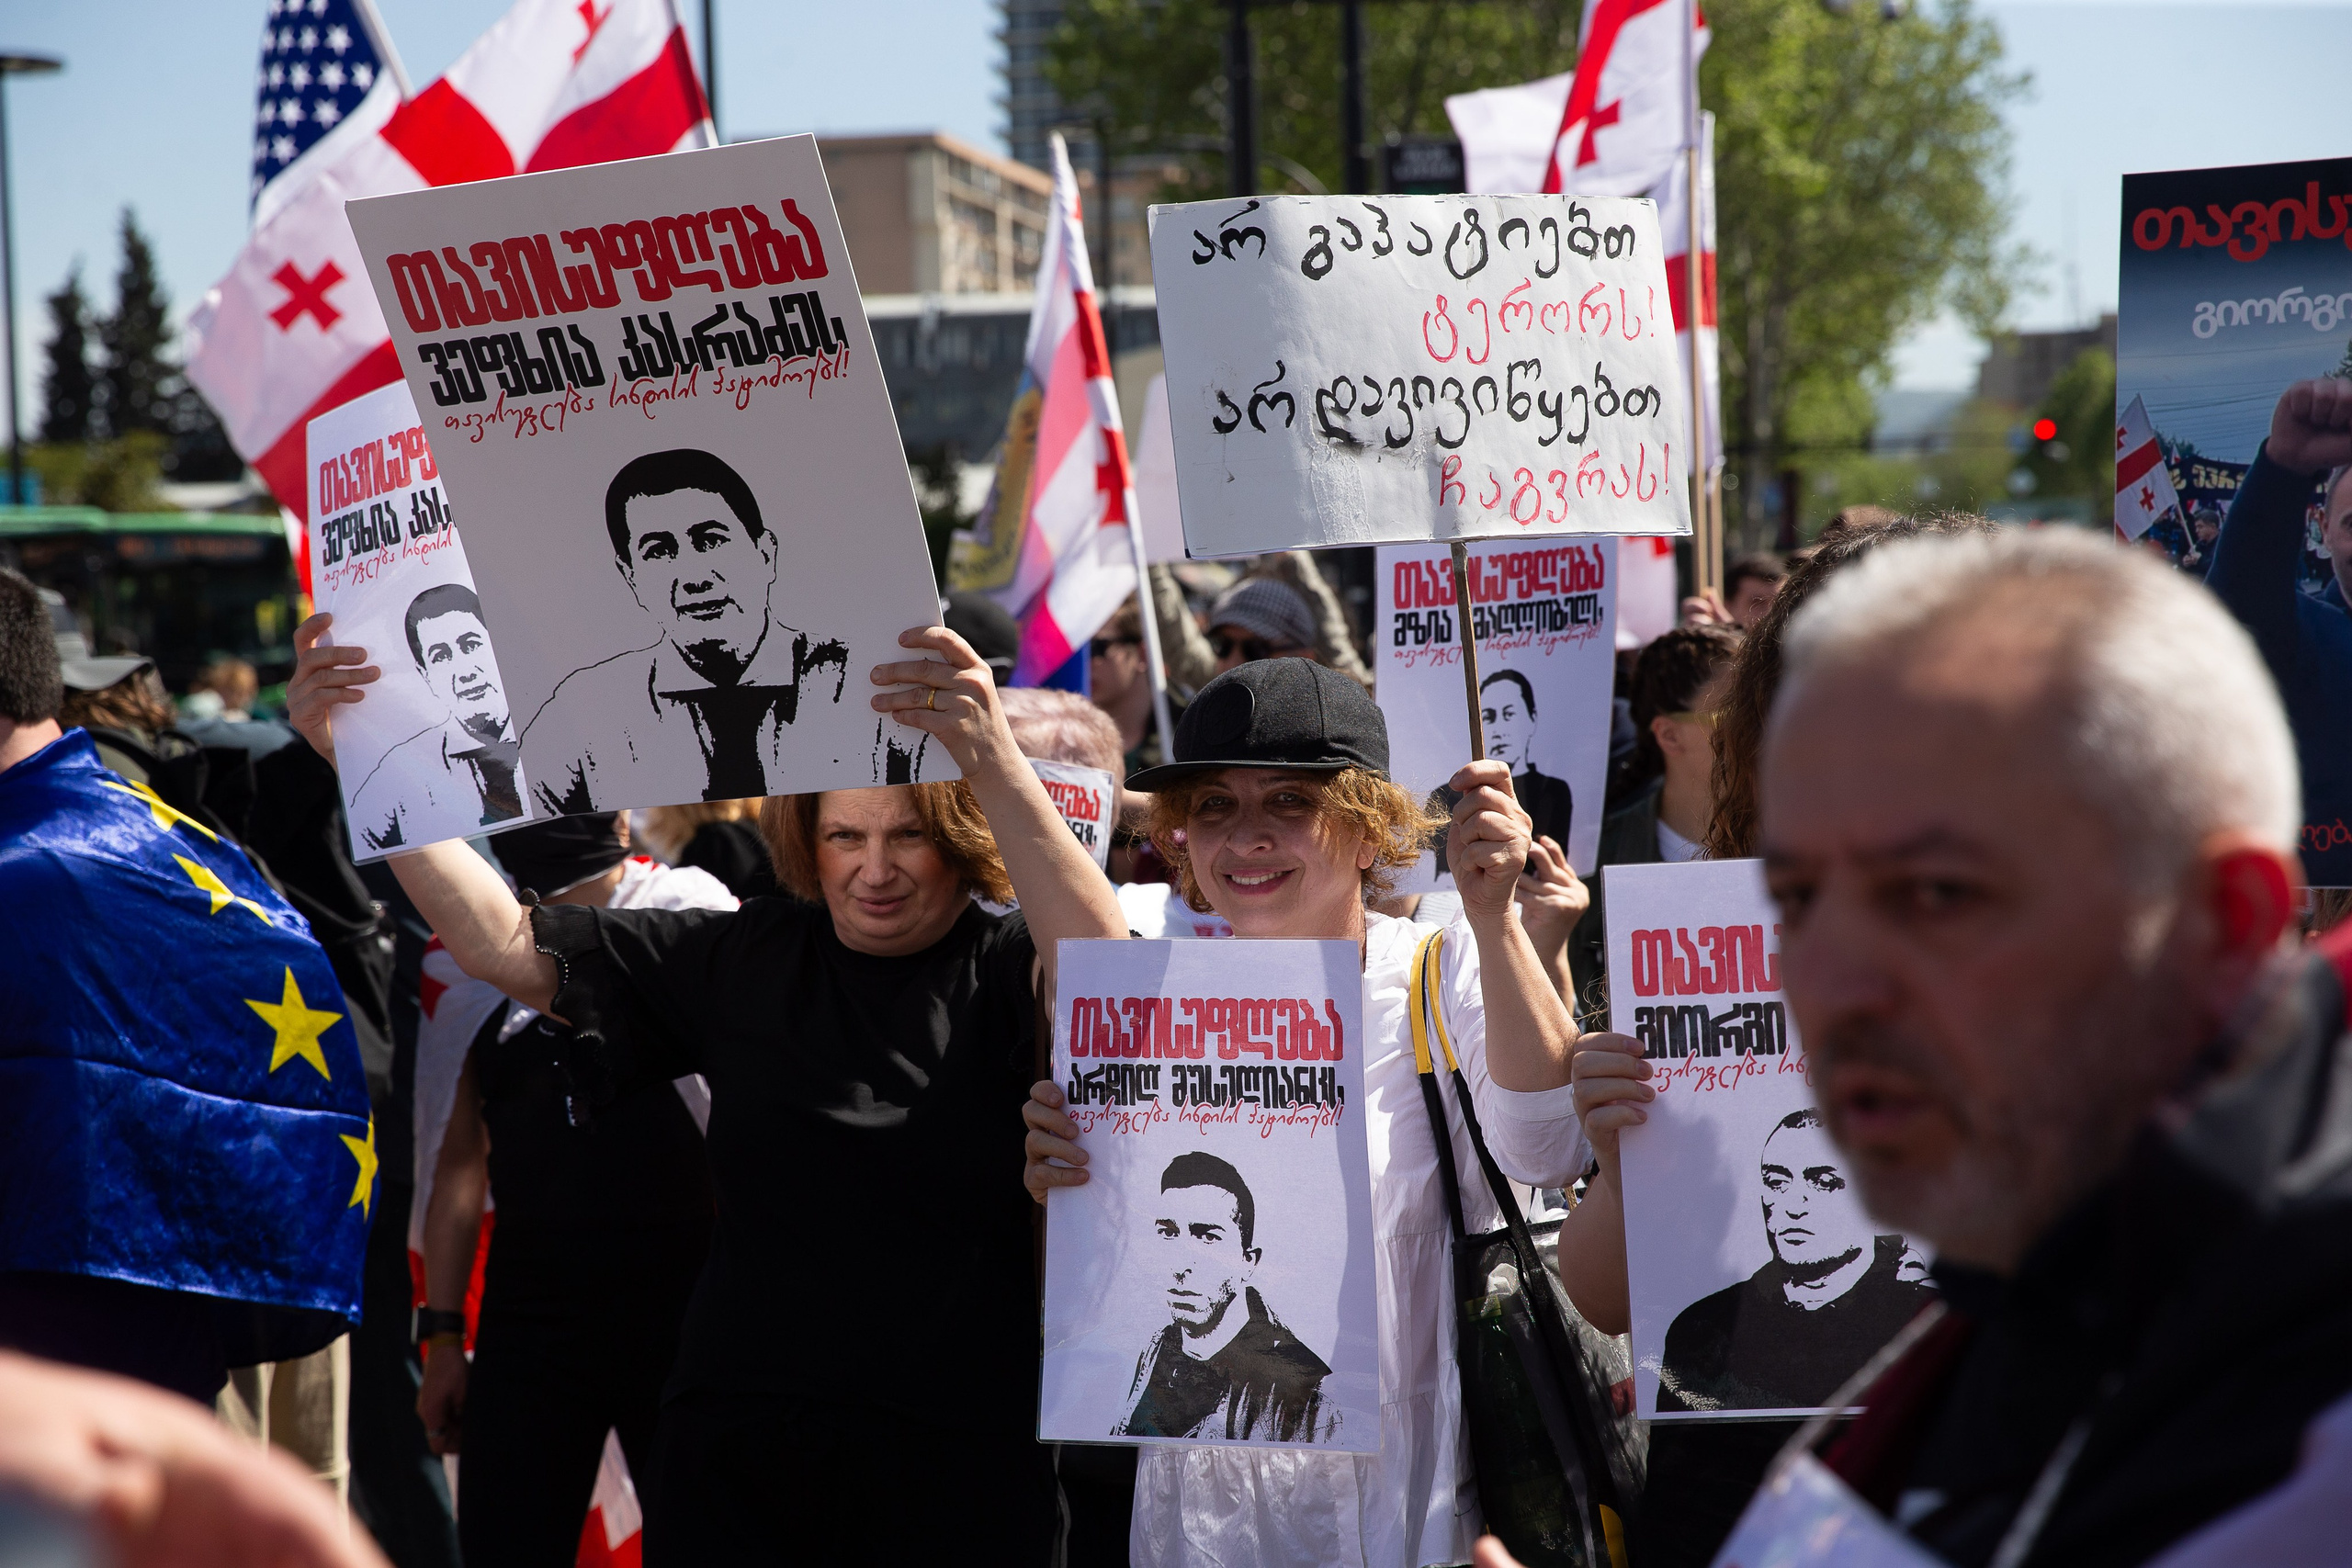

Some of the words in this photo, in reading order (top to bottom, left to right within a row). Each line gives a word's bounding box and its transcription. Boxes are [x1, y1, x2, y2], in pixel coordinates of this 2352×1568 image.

[1192, 199, 1266, 265] არ
[1300, 201, 1636, 280] გაპატიებთ
[2132, 181, 2352, 263] თავის
[387, 198, 829, 333] თავისუფლება
[418, 323, 606, 406] ვეფხია
[617, 290, 849, 381] კასრაძეს
[1422, 277, 1655, 366] ტერორს!
[445, 383, 594, 444] თავისუფლება
[608, 363, 701, 419] სინდისის
[712, 343, 851, 411] პატიმრებს!
[1212, 360, 1295, 434] არ
[1315, 357, 1661, 450] დავივიწყებთ
[319, 425, 439, 516] თავისუფ
[1439, 442, 1670, 525] ჩაგვრას!
[322, 501, 401, 568] ვეფხია
[323, 543, 396, 591] თავისუფლება
[1394, 543, 1604, 610] თავსუფლება
[1394, 609, 1452, 647] მზია
[1631, 923, 1784, 997] თავის
[1069, 997, 1344, 1061] თავისუფლება
[1634, 1001, 1787, 1059] გიორგი
[1068, 1062, 1160, 1106] არჩილ
[1171, 1064, 1345, 1110] მუსელიანცს
[1654, 1049, 1767, 1091] ავისუფლება
[1069, 1097, 1170, 1134] თავისუფლება
[1178, 1095, 1245, 1135] სინდისის
[1248, 1097, 1345, 1139] პატიმრებს!
